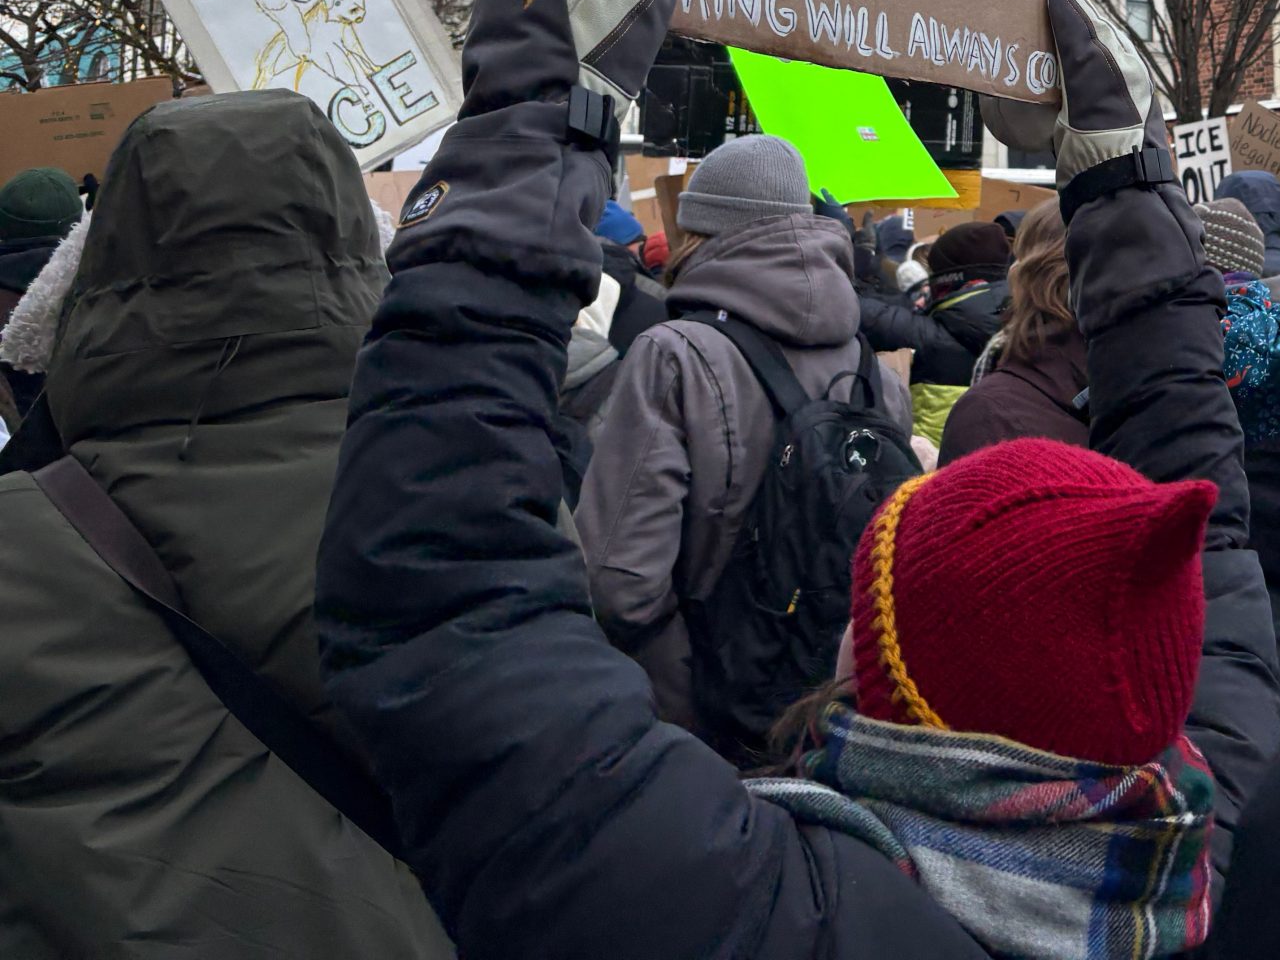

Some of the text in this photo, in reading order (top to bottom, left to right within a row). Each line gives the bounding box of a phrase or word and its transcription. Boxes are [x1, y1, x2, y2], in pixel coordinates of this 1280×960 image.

[907, 12, 1020, 87] ALWAYS
[1178, 125, 1223, 159] ICE
[1182, 159, 1228, 205] OUT
